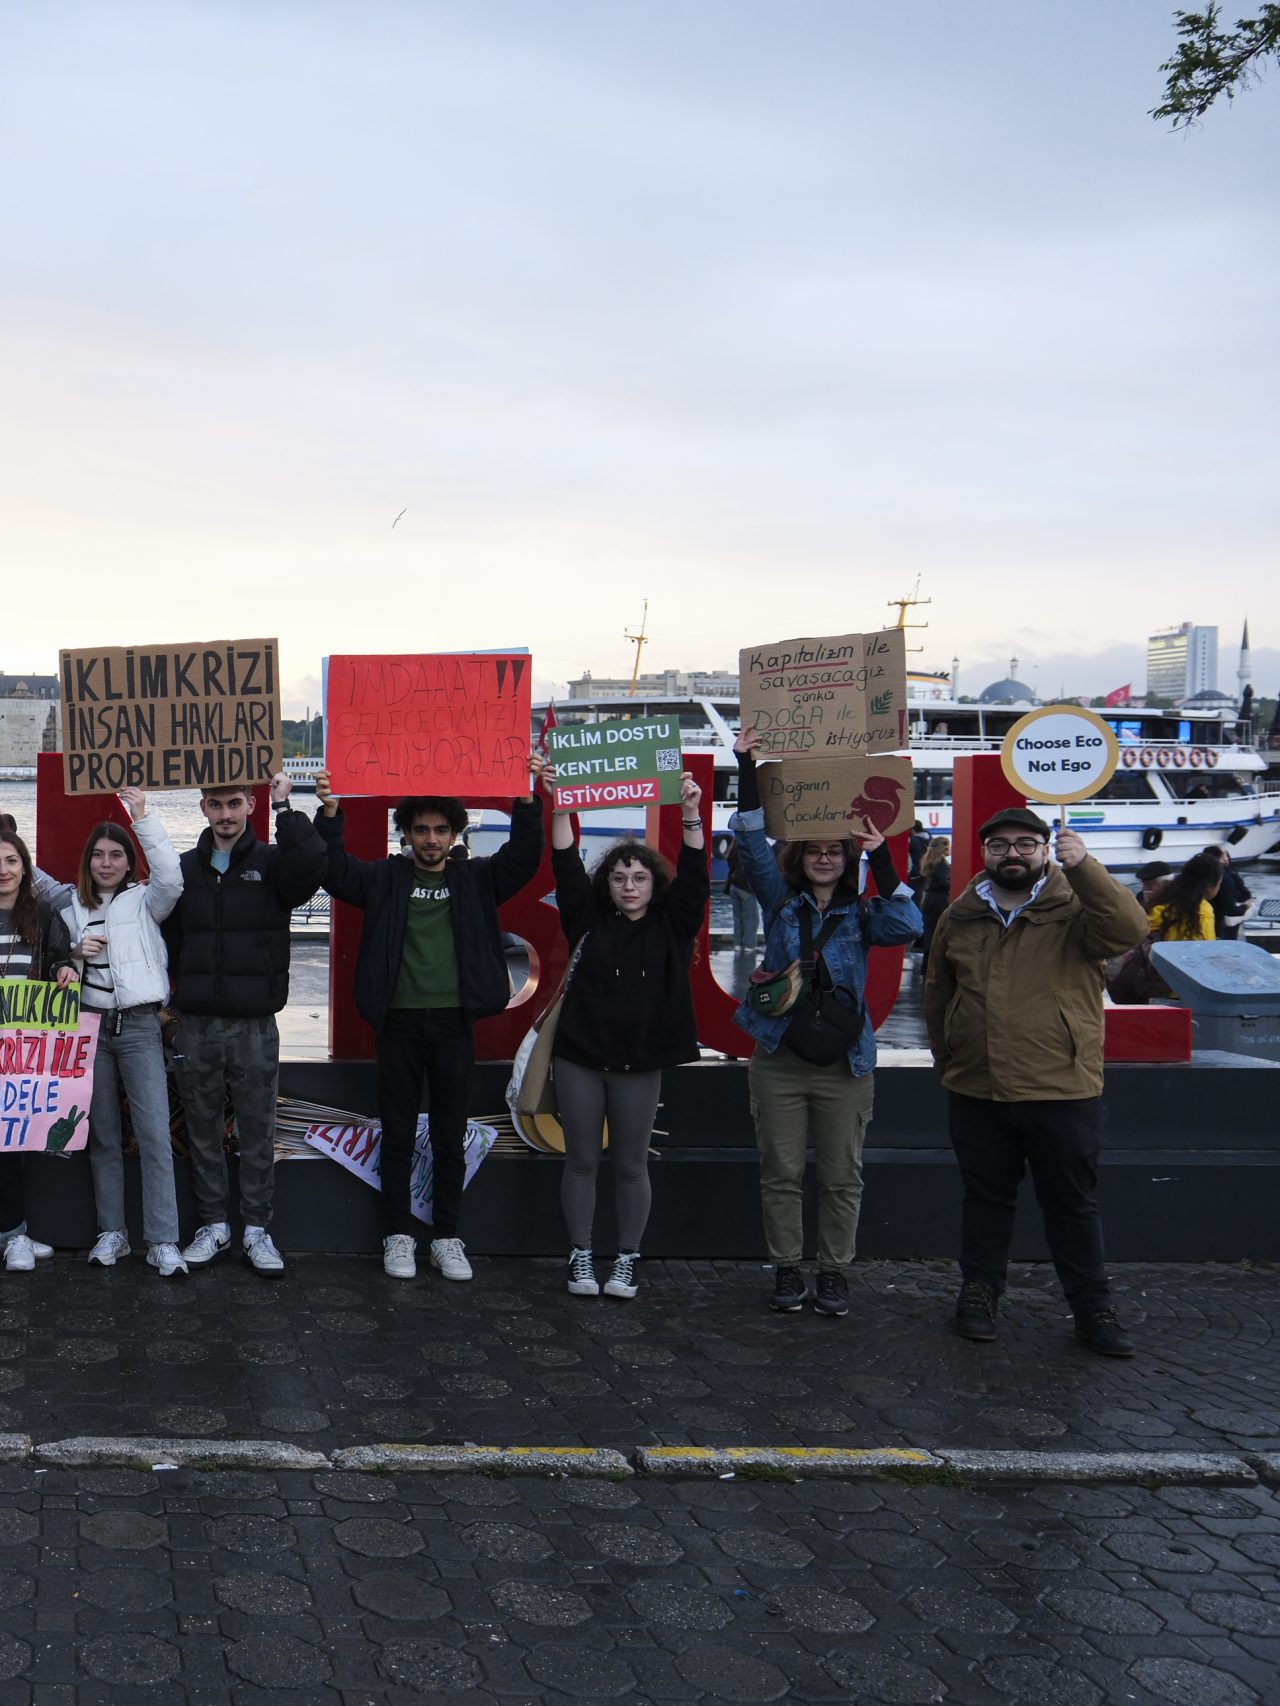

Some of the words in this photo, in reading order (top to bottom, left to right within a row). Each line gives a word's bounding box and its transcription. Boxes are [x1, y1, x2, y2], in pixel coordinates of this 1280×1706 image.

[866, 637, 891, 657] ile
[68, 701, 156, 751] İNSAN
[171, 700, 275, 746] HAKLARI
[752, 706, 823, 731] DOĞA
[552, 729, 602, 750] İKLİM
[606, 724, 670, 744] DOSTU
[757, 730, 816, 753] BARIŞ
[1016, 738, 1071, 750] Choose
[1075, 735, 1103, 748] Eco
[68, 742, 275, 792] PROBLEMİDİR
[555, 756, 638, 777] KENTLER
[1028, 760, 1057, 773] Not
[1061, 759, 1092, 773] Ego
[557, 783, 655, 805] İSTİYORUZ
[770, 777, 830, 802] Doğanın
[784, 803, 846, 826] Çocukları
[50, 1030, 92, 1079] İLE
